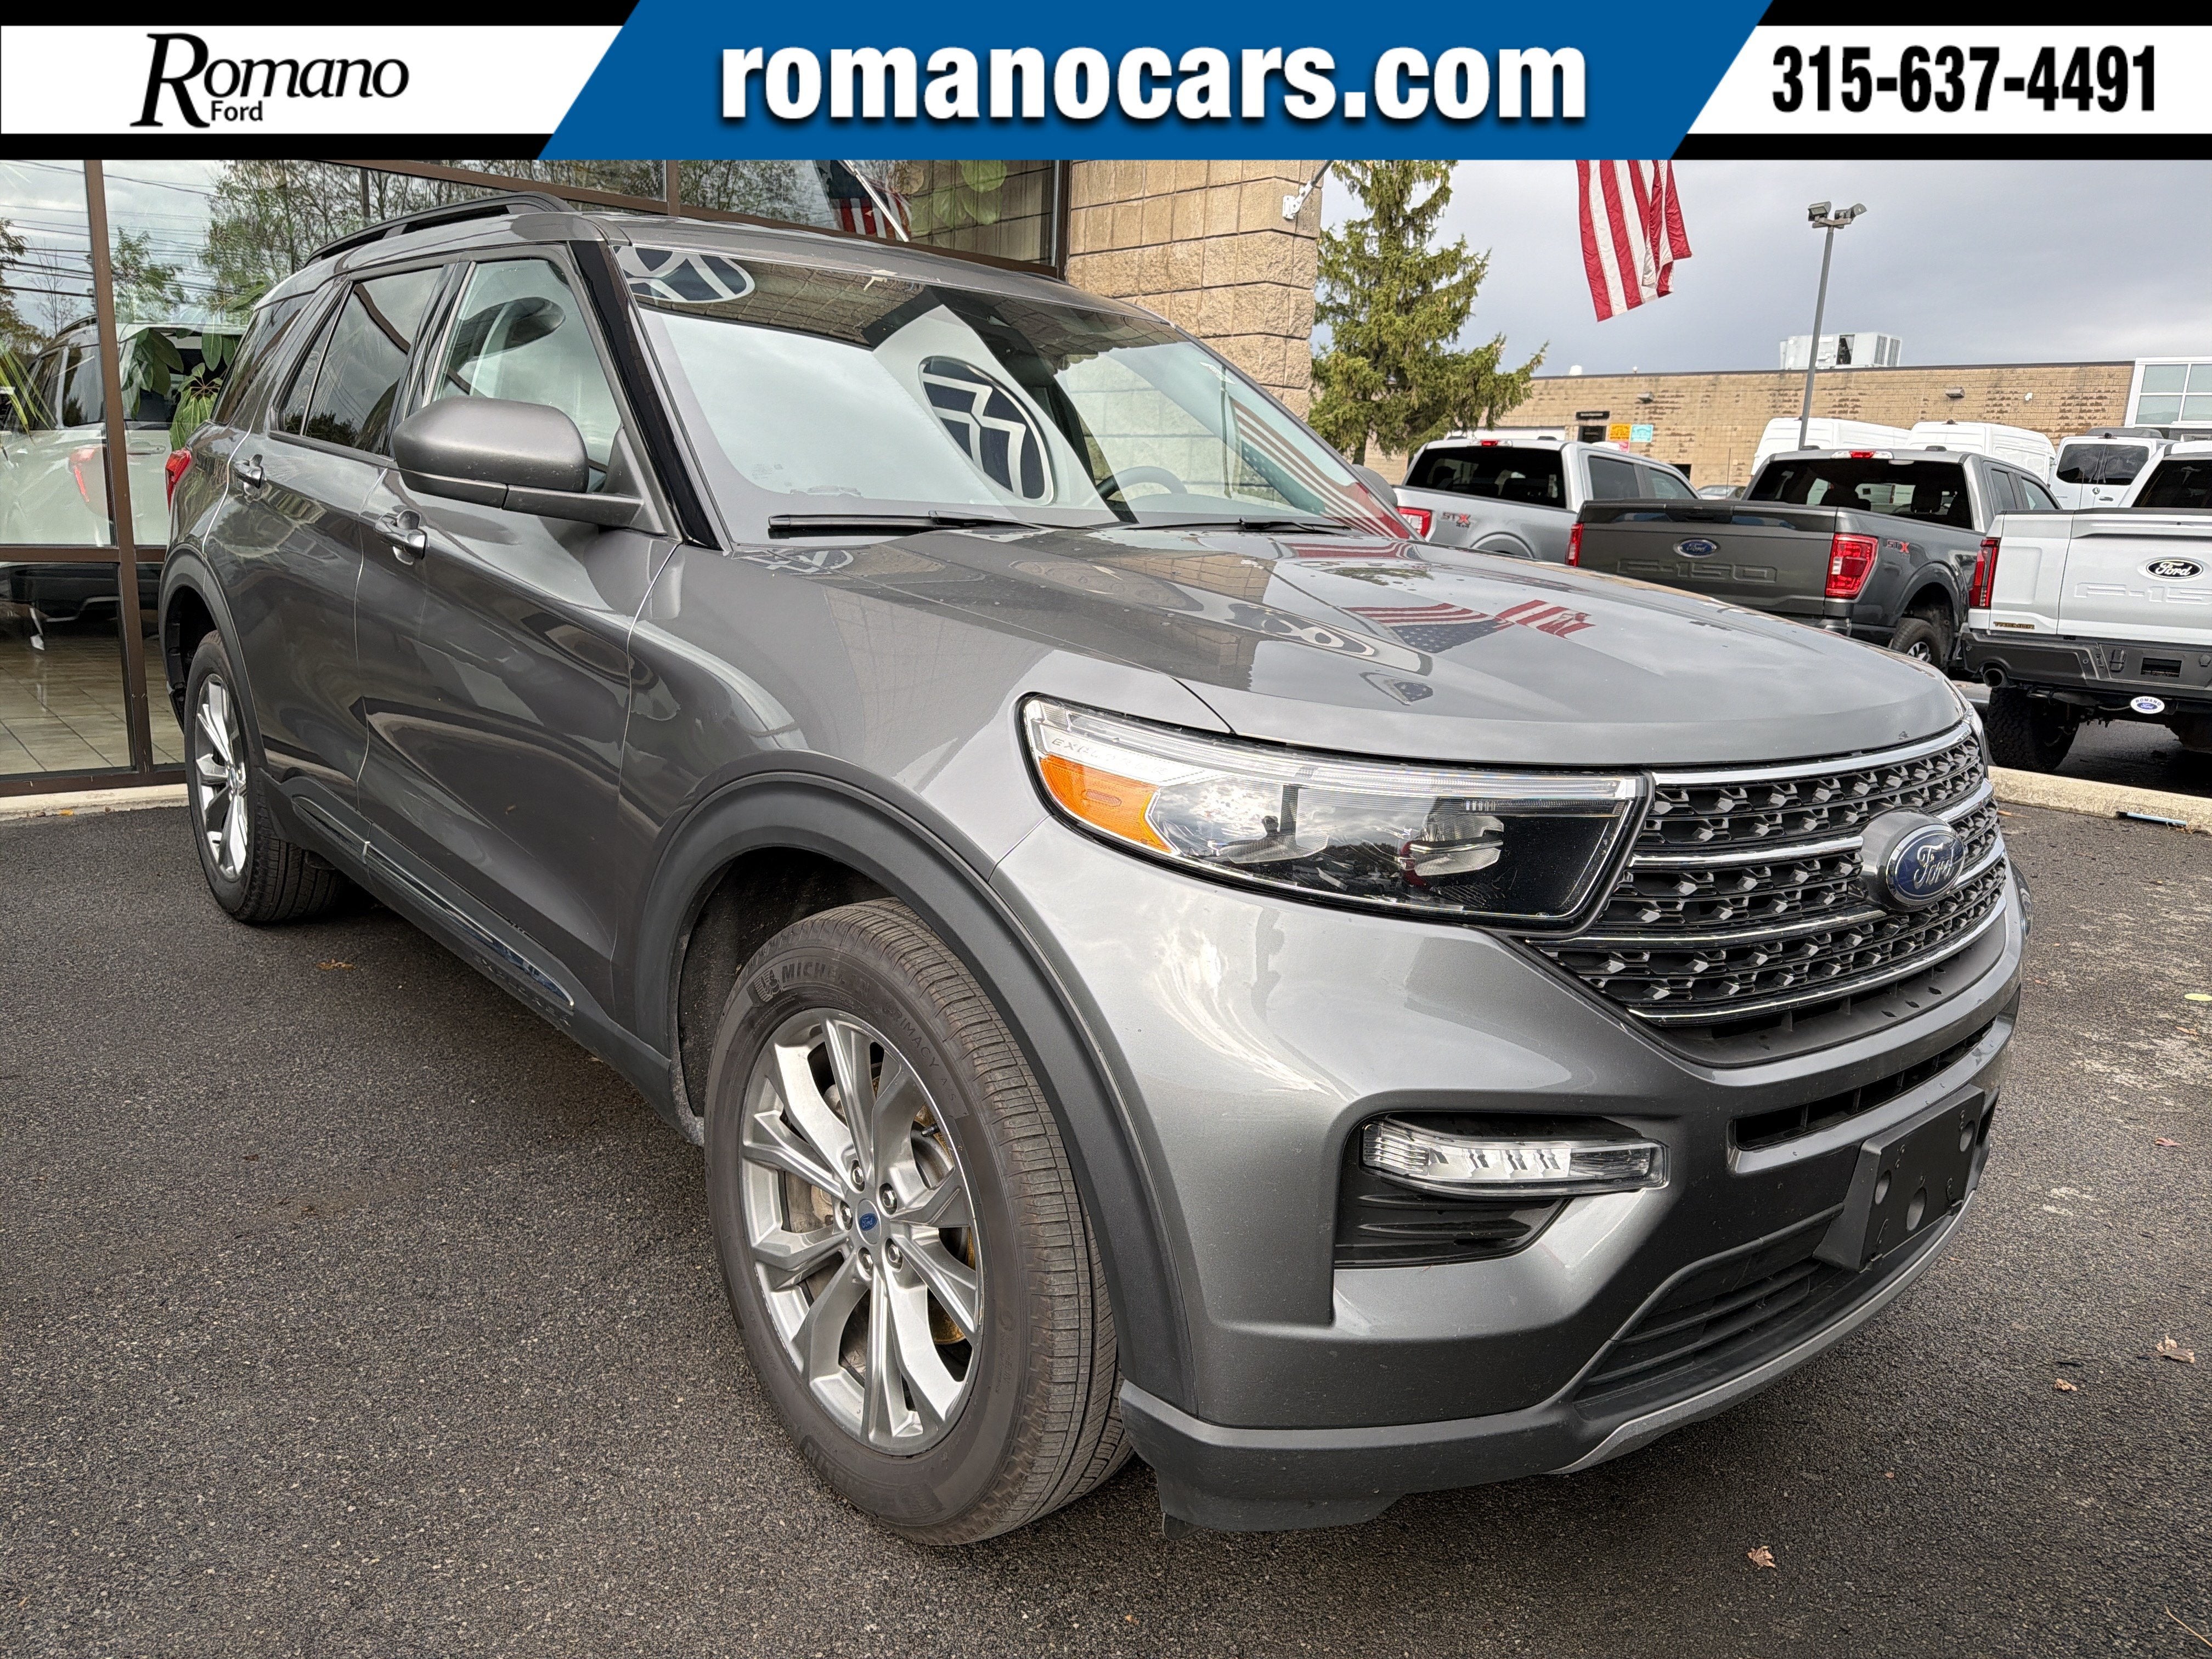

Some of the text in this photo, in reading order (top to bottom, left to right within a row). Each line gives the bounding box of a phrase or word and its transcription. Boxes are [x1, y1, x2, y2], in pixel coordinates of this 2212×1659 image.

[1887, 539, 1910, 554] STX
[1616, 558, 1778, 583] F-150
[2154, 561, 2194, 577] Ford
[2135, 698, 2162, 706] ROMANO
[1914, 842, 1956, 890] Ford
[862, 1216, 873, 1228] Ford
